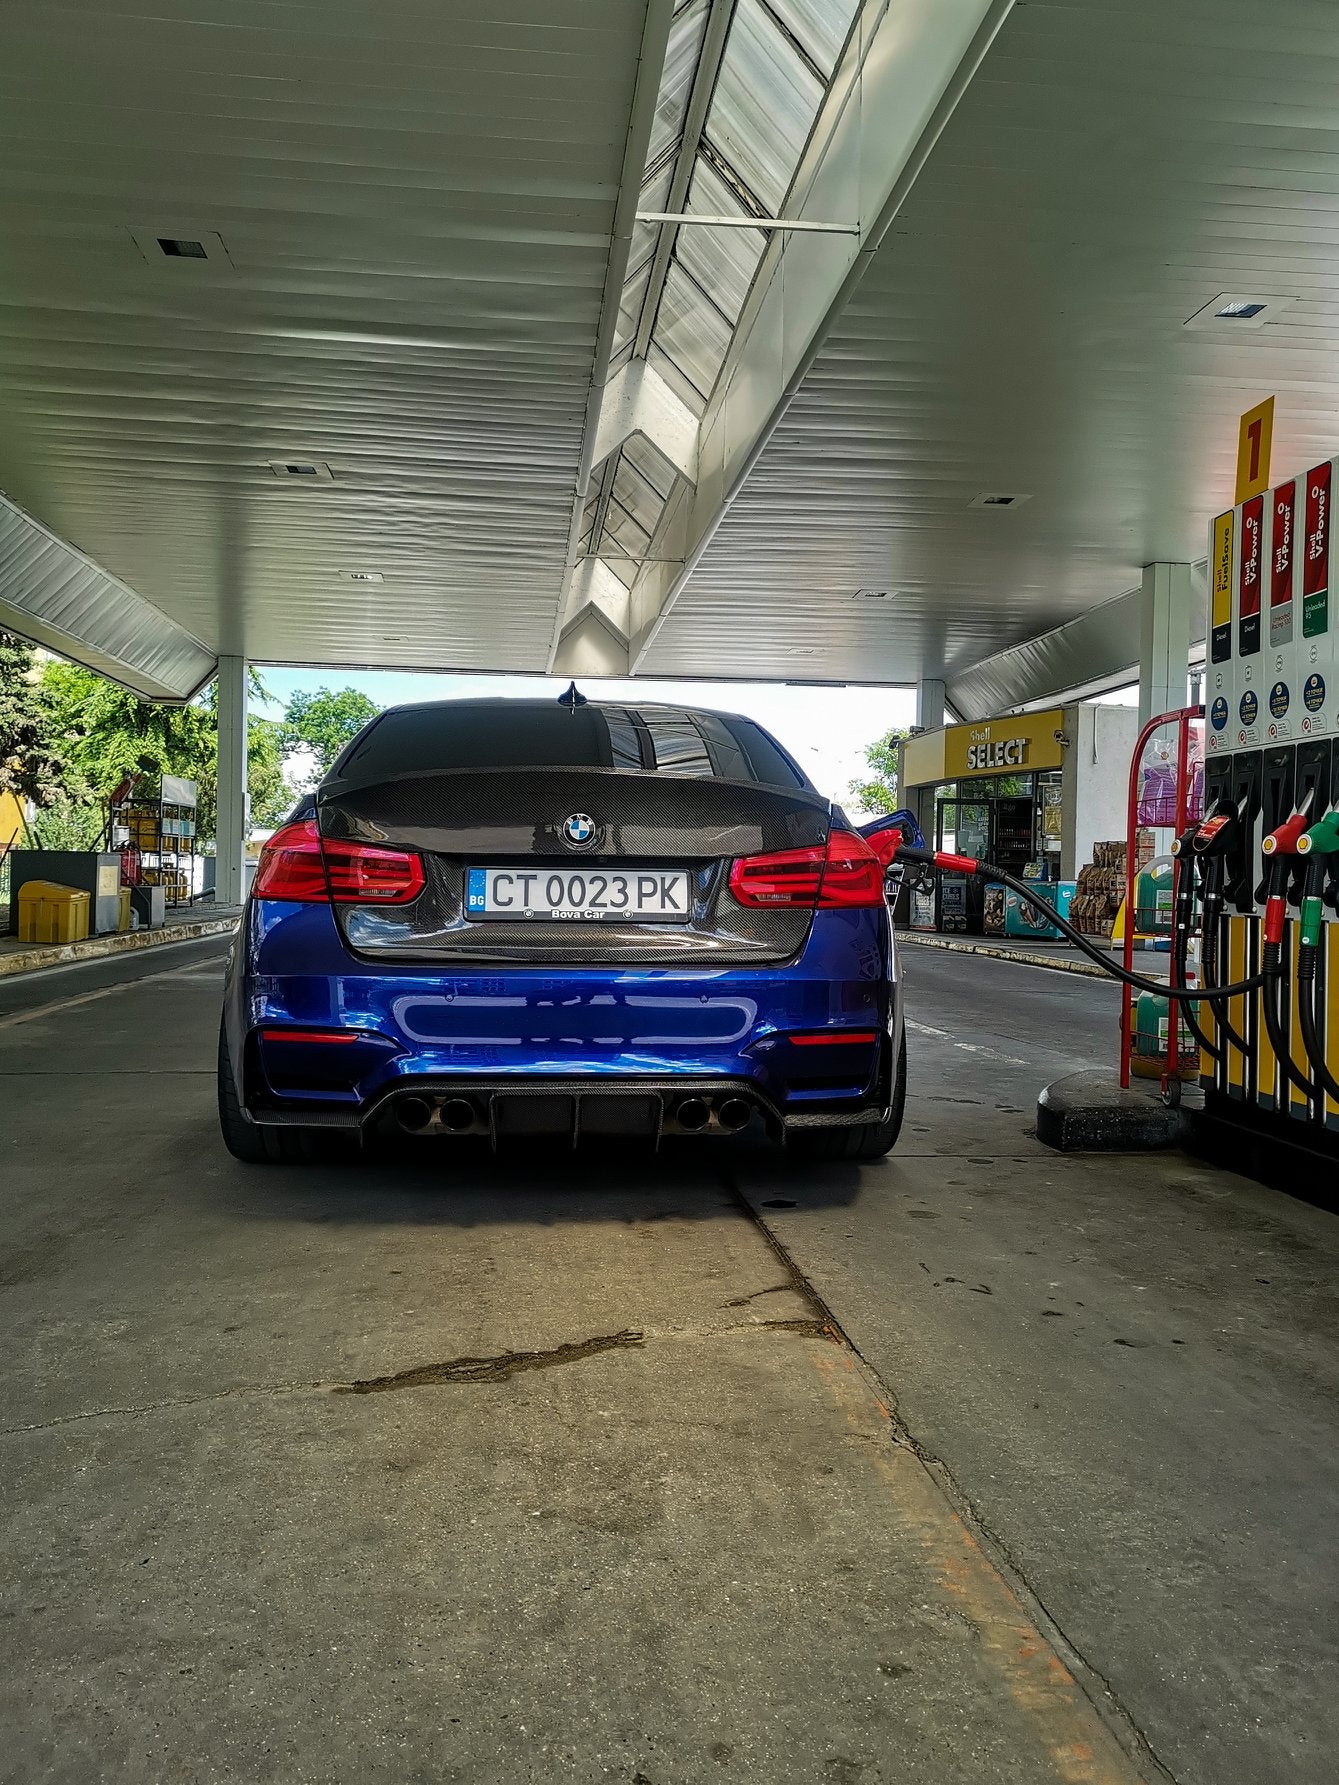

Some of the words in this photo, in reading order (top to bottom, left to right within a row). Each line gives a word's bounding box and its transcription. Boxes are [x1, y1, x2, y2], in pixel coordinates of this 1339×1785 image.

[1248, 418, 1262, 482] 1
[1281, 505, 1291, 572] V-Power
[1316, 488, 1325, 558] V-Power
[1249, 520, 1258, 583] V-Power
[970, 727, 991, 741] Shell
[967, 738, 1026, 769] SELECT
[469, 895, 485, 906] BG
[492, 874, 538, 907] CT
[545, 874, 628, 908] 0023
[637, 876, 681, 910] PK
[551, 909, 581, 919] Bova
[584, 909, 606, 919] Car
